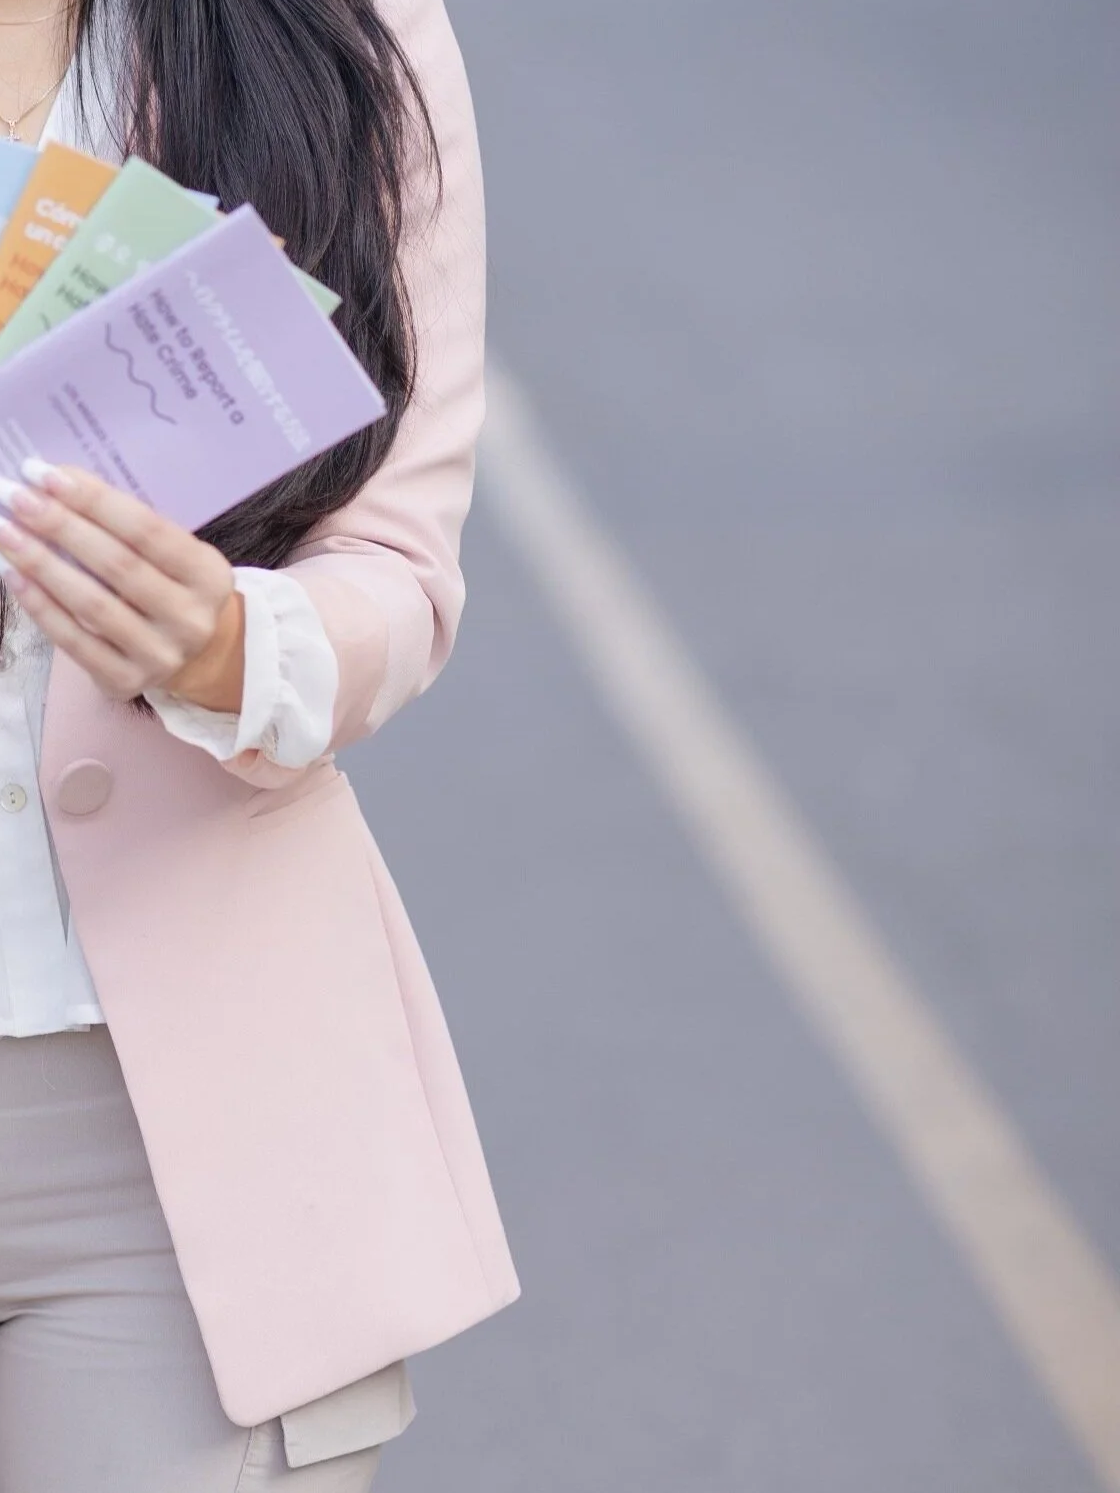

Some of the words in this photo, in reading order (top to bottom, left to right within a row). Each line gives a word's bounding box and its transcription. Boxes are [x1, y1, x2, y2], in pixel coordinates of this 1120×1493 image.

[129, 302, 160, 345] Hate
[156, 343, 198, 400] Crime
[150, 288, 179, 328] How
[175, 326, 194, 349] to
[189, 346, 236, 411] Report
[230, 409, 245, 426] a
